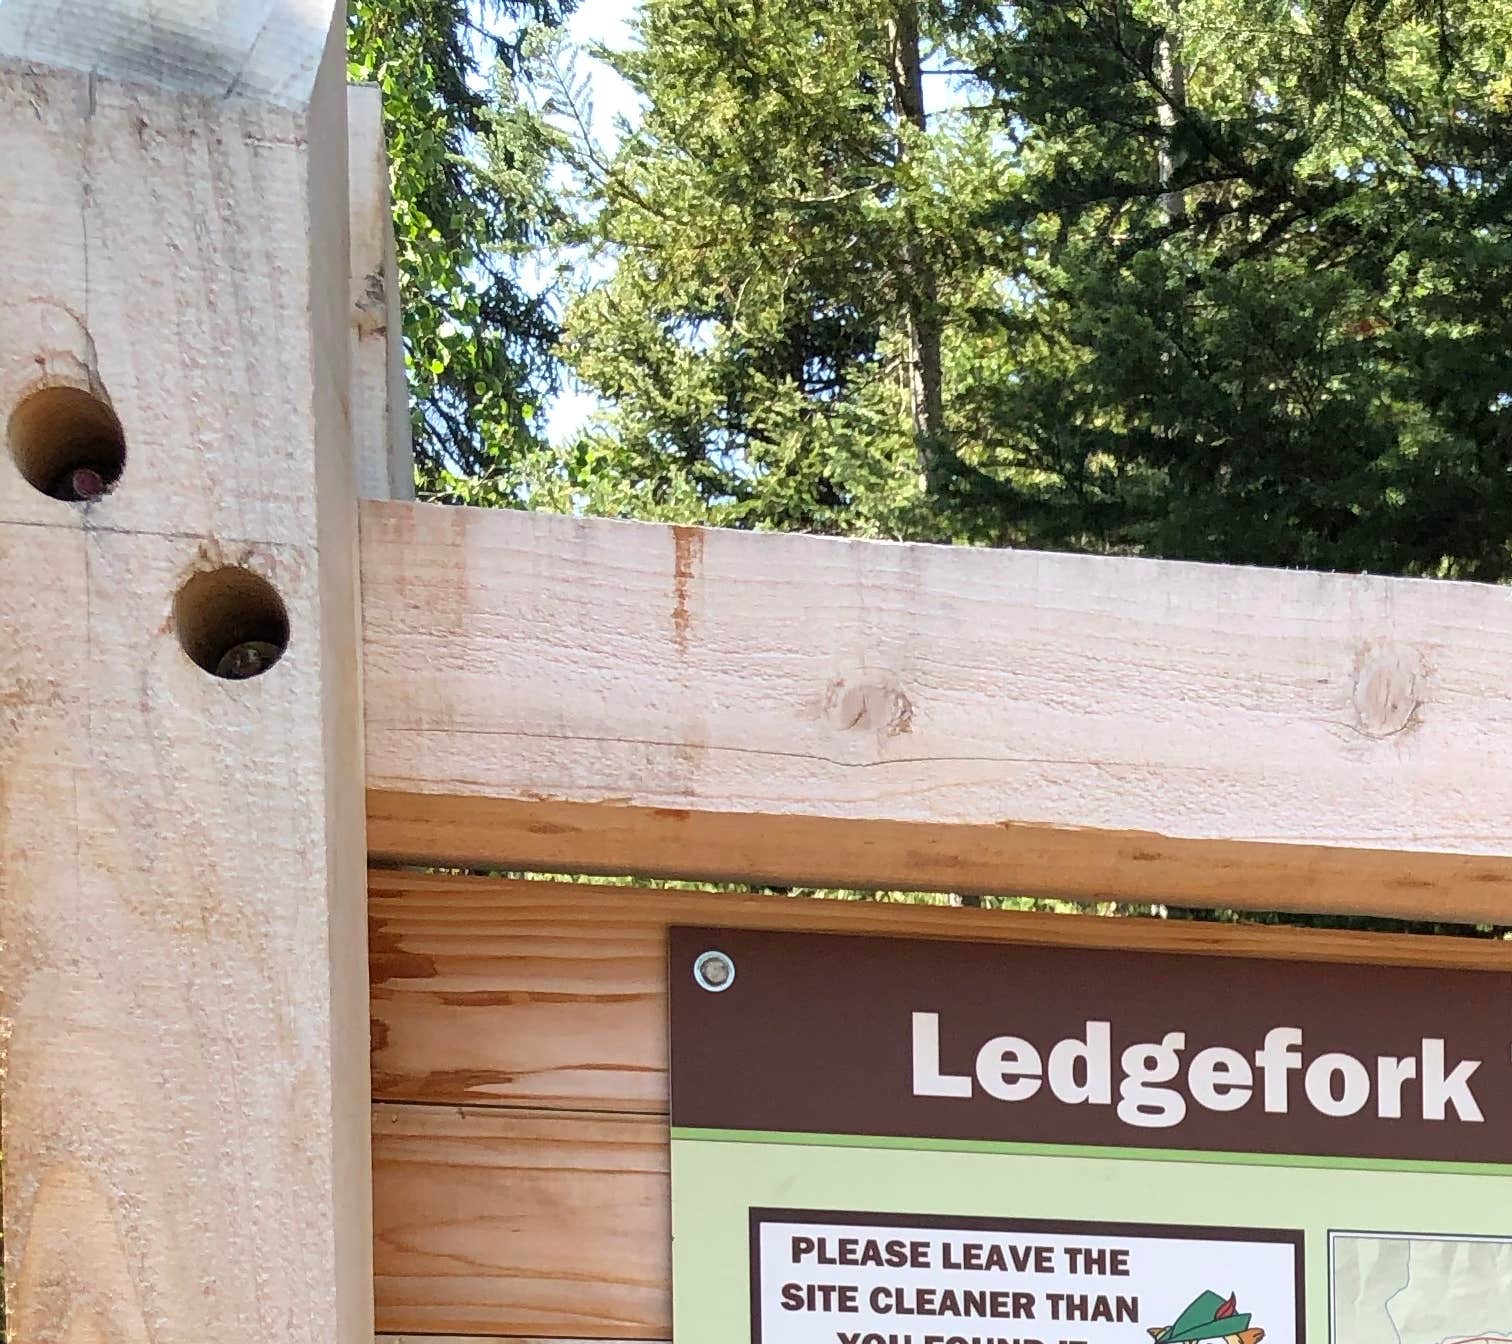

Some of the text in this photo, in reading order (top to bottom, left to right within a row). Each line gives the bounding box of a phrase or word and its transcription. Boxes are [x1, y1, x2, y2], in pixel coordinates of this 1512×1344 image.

[912, 1011, 1484, 1125] Ledgefork
[791, 1236, 1130, 1276] PLEASE LEAVE THE
[780, 1283, 1139, 1322] SITE CLEANER THAN
